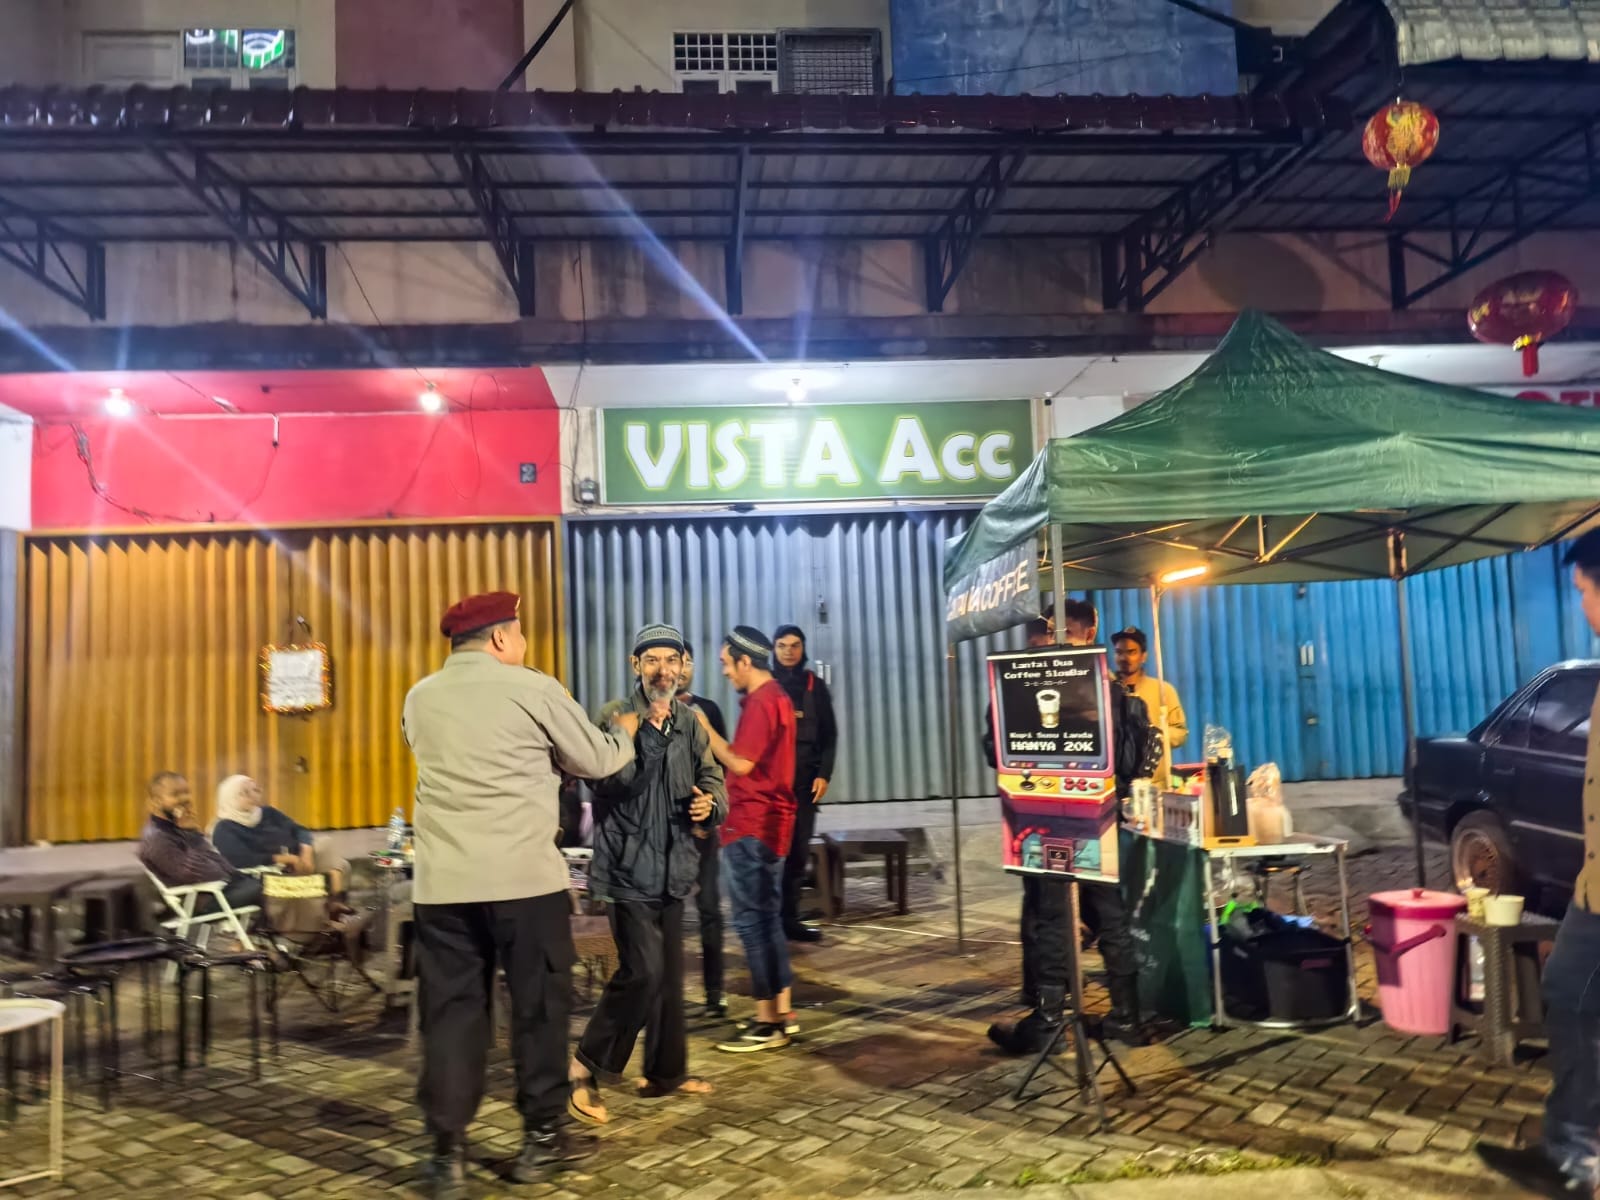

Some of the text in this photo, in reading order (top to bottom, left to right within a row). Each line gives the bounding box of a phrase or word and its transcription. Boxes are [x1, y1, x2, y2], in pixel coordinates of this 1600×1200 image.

[626, 418, 860, 490] VISTA
[1012, 659, 1073, 669] Lantai Dua
[1004, 671, 1041, 679] Coffee
[1010, 741, 1094, 752] HANYA 20K
